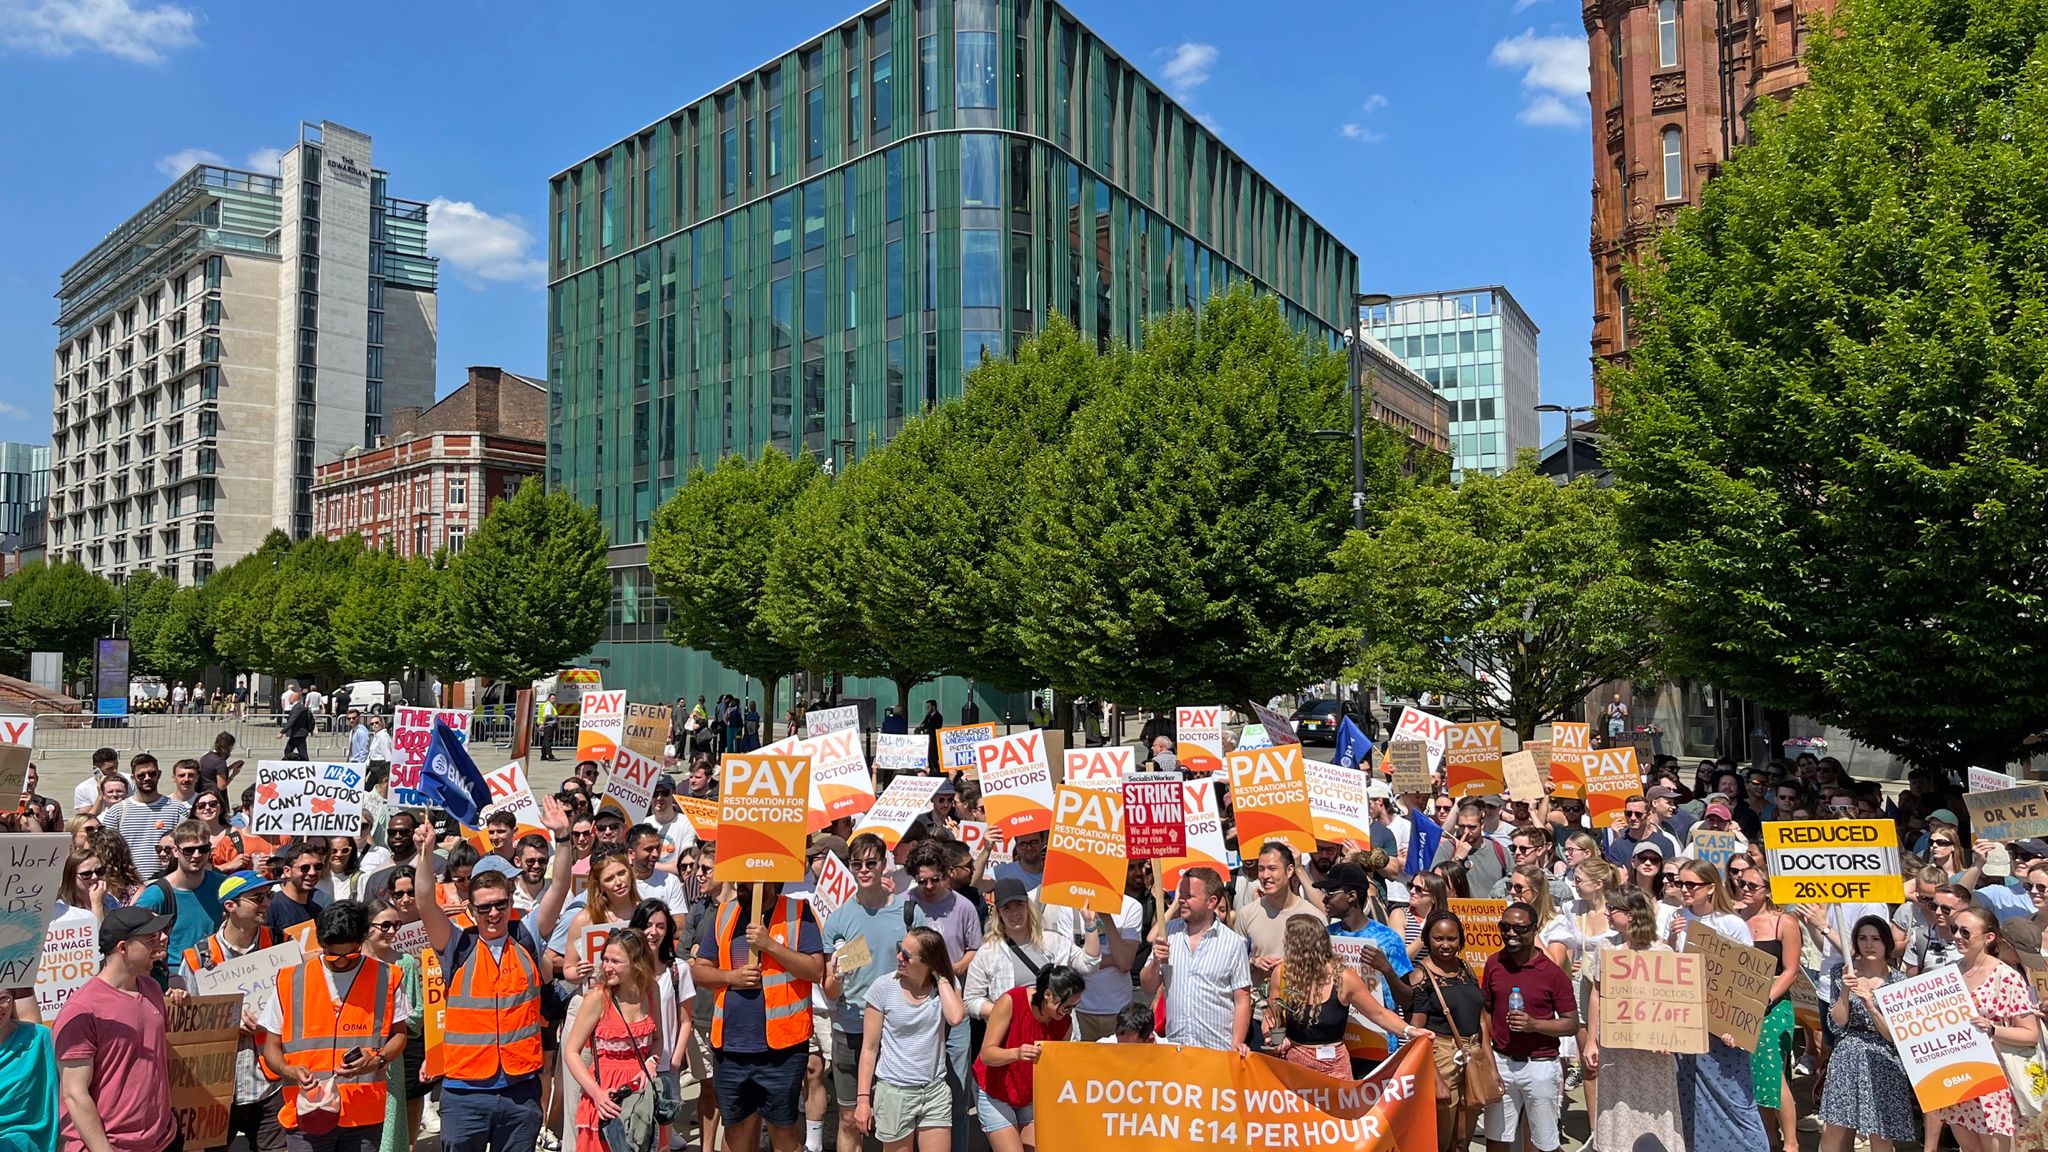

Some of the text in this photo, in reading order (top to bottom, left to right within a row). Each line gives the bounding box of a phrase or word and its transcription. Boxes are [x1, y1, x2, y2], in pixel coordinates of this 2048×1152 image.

[327, 160, 368, 178] EDWARDIAN
[341, 156, 354, 166] THE
[583, 693, 623, 714] PAY
[630, 705, 667, 719] EVEN
[398, 709, 432, 727] THE
[582, 719, 621, 728] DOCTORS
[807, 708, 857, 723] WHY DO YOU
[1179, 709, 1218, 727] PAY
[809, 723, 829, 735] ONLY
[946, 727, 989, 738] OVERWORKED
[1400, 710, 1445, 740] PAY
[395, 728, 432, 750] GOOD
[946, 735, 989, 744] UNDERVALUED
[1179, 732, 1220, 741] DOCTORS
[1395, 733, 1440, 757] DORS
[1447, 725, 1496, 749] PAY
[1552, 725, 1587, 747] PAY
[802, 731, 852, 763] PAY
[978, 734, 1038, 773] PAY
[405, 748, 426, 765] IS
[1068, 751, 1130, 780] PAY
[1449, 752, 1499, 764] DOCTORS
[1582, 750, 1632, 776] PAY
[259, 765, 360, 787] BROKEN NHS
[613, 750, 658, 788] PAY
[814, 761, 863, 781] OCTORS
[983, 762, 1045, 780] RESTORATION FOR
[1230, 749, 1297, 787] PAY
[448, 764, 475, 794] BMA
[487, 766, 518, 798] AY
[724, 760, 806, 796] PAY
[984, 770, 1046, 793] DOCTORS
[1342, 778, 1362, 787] WAGE
[1587, 780, 1639, 792] DOCTORS
[1971, 774, 2000, 787] £14/HOUR
[304, 781, 362, 804] DOCTORS
[607, 782, 648, 809] DOCTORS
[1125, 784, 1180, 804] STRIKE
[1235, 782, 1286, 795] RESTORATION
[1331, 782, 1363, 794] JUNIOR
[724, 797, 785, 806] RESTORATION
[786, 797, 805, 806] FOR
[878, 797, 925, 808] DOCTOR
[1236, 789, 1305, 809] DOCTORS
[1309, 797, 1359, 814] FULL PAY
[722, 807, 804, 822] DOCTORS
[873, 809, 893, 817] FULL
[1018, 815, 1034, 823] BMA
[1056, 790, 1124, 833] PAY
[1125, 803, 1182, 824] TO WIN
[1201, 812, 1215, 820] FOR
[1984, 804, 2038, 822] OR WE
[256, 813, 360, 832] FIX PATIENTS
[1130, 826, 1167, 835] We all need
[1055, 825, 1110, 840] RESTORATION
[1137, 837, 1148, 845] pay
[1150, 835, 1163, 843] rise
[1695, 834, 1735, 849] CASH
[1779, 826, 1878, 843] REDUCED
[1052, 834, 1126, 858] DOCTORS
[1131, 846, 1180, 856] Strike together
[11, 844, 60, 868] Work
[755, 859, 775, 867] BMA
[1698, 850, 1731, 864] NOT
[1781, 854, 1881, 870] DOCTORS
[4, 874, 43, 898] Pay
[820, 857, 856, 904] PAY
[1078, 888, 1096, 897] BMA
[1832, 882, 1870, 898] OFF
[813, 894, 832, 920] DOCT
[1452, 905, 1505, 914] £14/HOUR IS
[79, 926, 92, 937] IS
[1466, 933, 1502, 946] OCTO
[61, 939, 92, 950] WAGE
[404, 936, 429, 947] WAGE
[42, 950, 93, 967] JUNIOR
[1739, 952, 1772, 975] ONLY
[35, 962, 95, 984] CTOR
[205, 964, 258, 989] JUNIOR
[1610, 955, 1693, 985] SALE
[237, 975, 277, 996] SALE
[1707, 979, 1733, 999] IS A
[1731, 970, 1765, 995] TORY
[1882, 972, 1958, 1006] £14/HOUR IS
[1610, 986, 1695, 999] JUNIOR DOCTORS
[1886, 984, 1962, 1014] NOT A FAIR WAGE
[1617, 1000, 1691, 1023] 26% OFF
[1706, 994, 1761, 1035] POSITORY
[1890, 994, 1967, 1026] FOR A JUNIOR
[1894, 1005, 1972, 1041] DOCTOR
[1613, 1031, 1640, 1043] ONLY
[1910, 1028, 1974, 1057] FULL PAY
[1915, 1041, 1978, 1064] RESTORATION NOW
[1952, 1073, 1972, 1085] BMA
[1057, 1074, 1415, 1114] A DOCTOR IS WORTH MORE
[1102, 1113, 1381, 1148] THAN £14 PER HOUR
